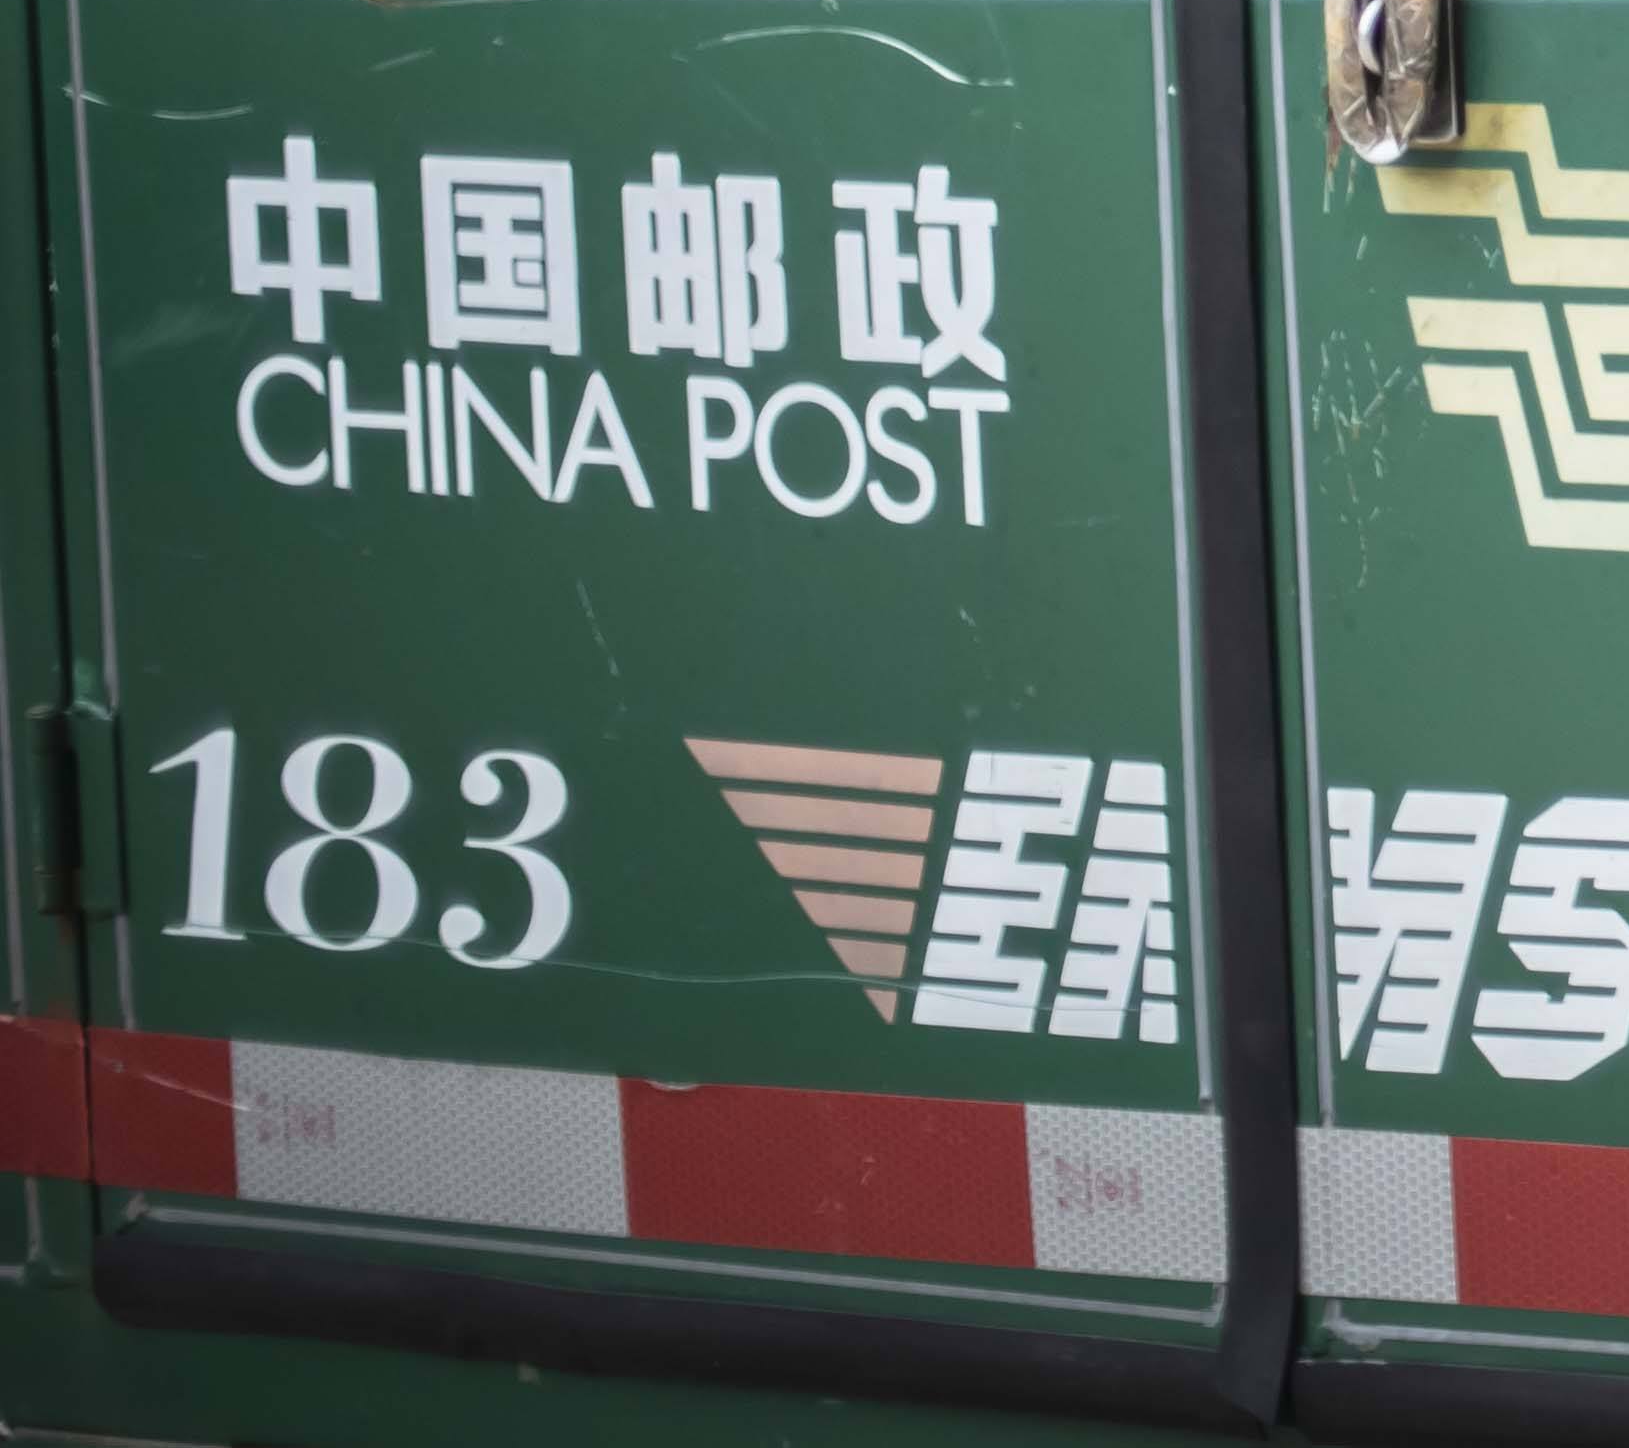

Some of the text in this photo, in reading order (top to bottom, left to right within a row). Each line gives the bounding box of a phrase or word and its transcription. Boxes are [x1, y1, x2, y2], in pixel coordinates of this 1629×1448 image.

[225, 136, 1007, 381] 中国邮政
[237, 354, 1010, 527] CHINA POST
[149, 725, 576, 972] 183
